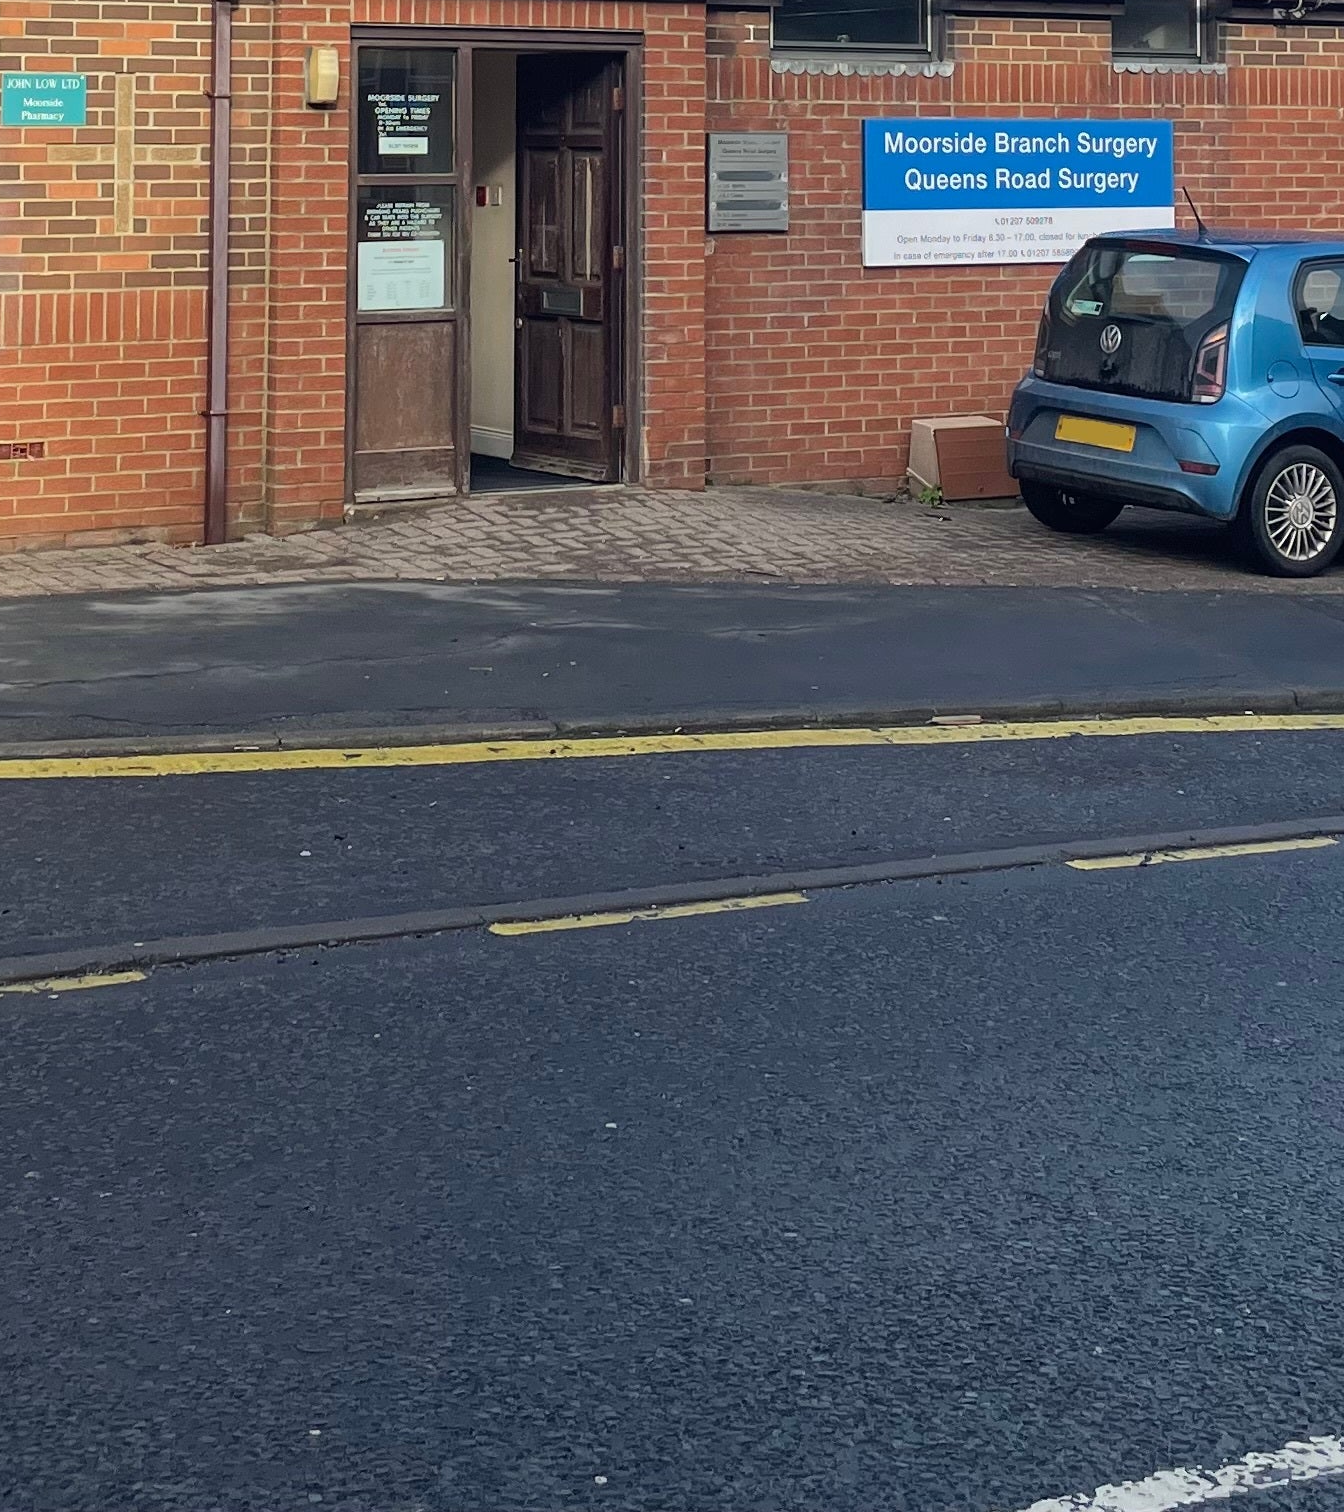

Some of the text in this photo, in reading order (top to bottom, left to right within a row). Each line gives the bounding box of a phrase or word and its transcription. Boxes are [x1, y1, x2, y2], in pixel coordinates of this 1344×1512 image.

[7, 78, 80, 89] JOHN LOW LTD
[23, 98, 64, 107] Moorside
[22, 111, 65, 122] Pharmacy
[884, 132, 1157, 158] Moorside Branch Surgery
[905, 167, 1139, 193] Queens Road Surgery
[897, 235, 918, 244] Open
[920, 235, 951, 244] Monday
[963, 234, 986, 243] Friday
[1039, 232, 1064, 241] closed
[1065, 232, 1075, 240] for
[923, 251, 932, 259] of
[933, 252, 976, 261] emergency
[977, 250, 994, 258] after
